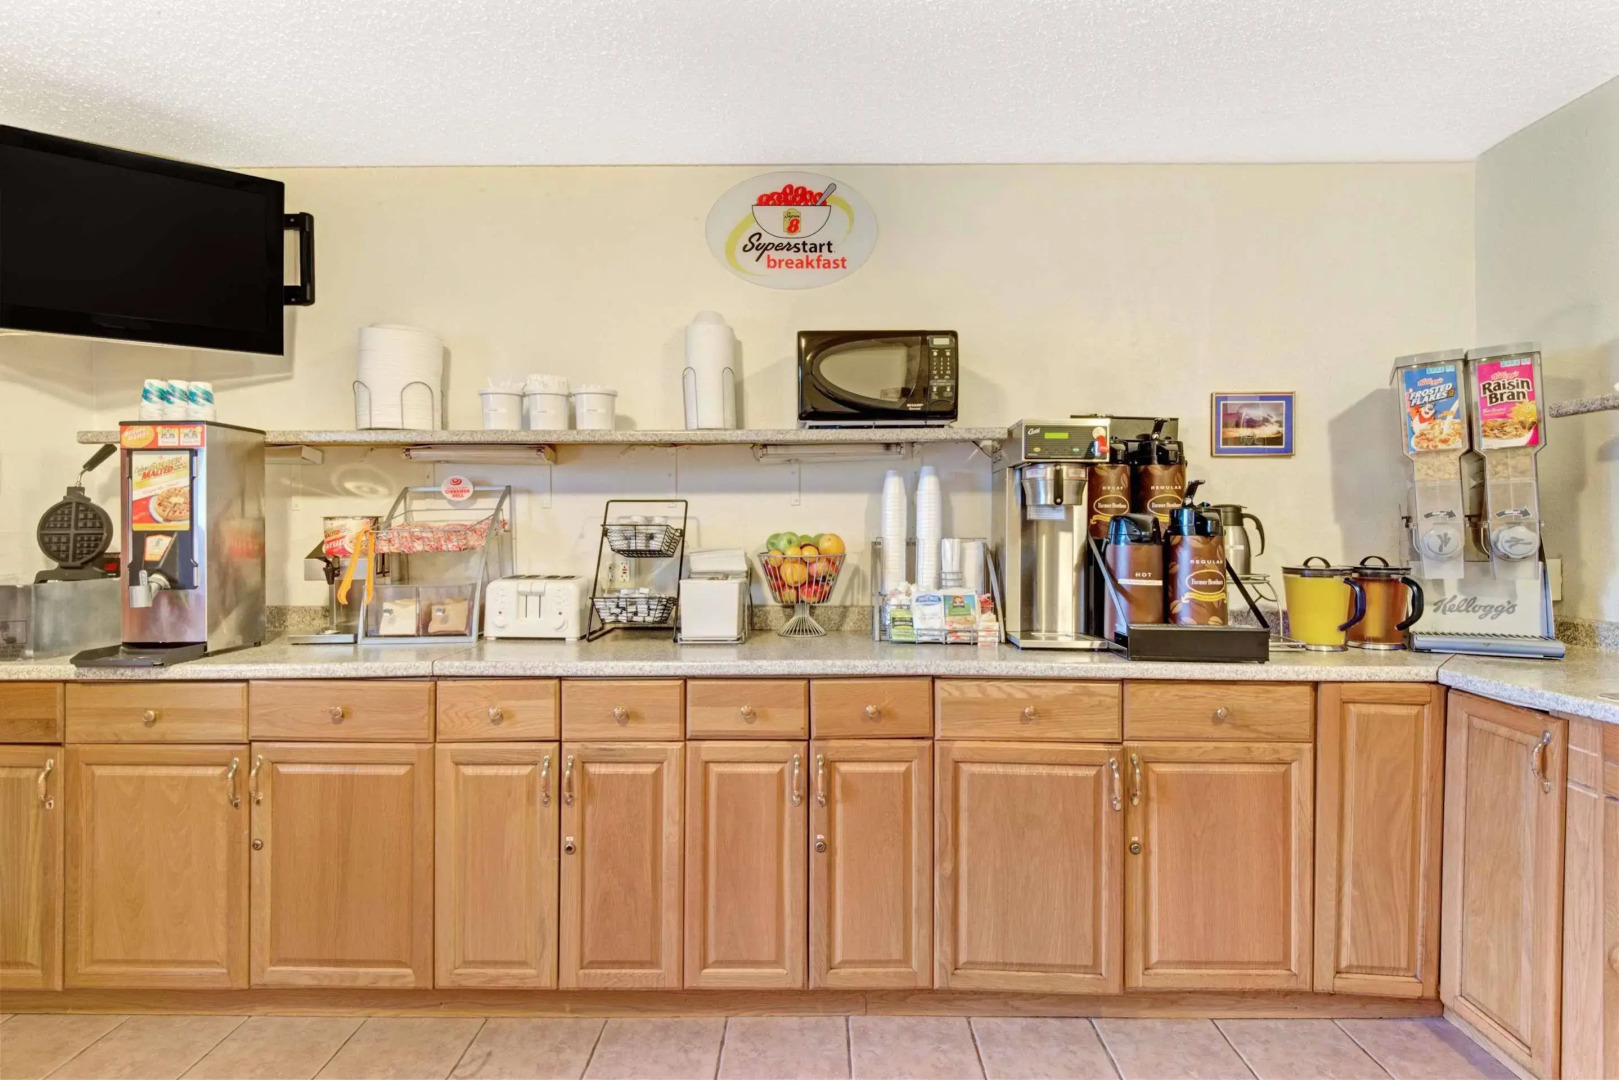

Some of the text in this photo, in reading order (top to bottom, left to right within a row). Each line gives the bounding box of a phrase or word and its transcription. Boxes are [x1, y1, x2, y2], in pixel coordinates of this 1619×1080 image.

[787, 218, 800, 234] 8
[742, 232, 833, 262] Superstart
[766, 254, 847, 269] breakfast
[1409, 383, 1453, 400] FROSTED
[1482, 378, 1531, 395] Raisin
[1410, 390, 1448, 407] FLAKES
[1488, 390, 1527, 405] Bran
[141, 465, 174, 481] MALTED
[1433, 595, 1518, 620] Kellogg's
